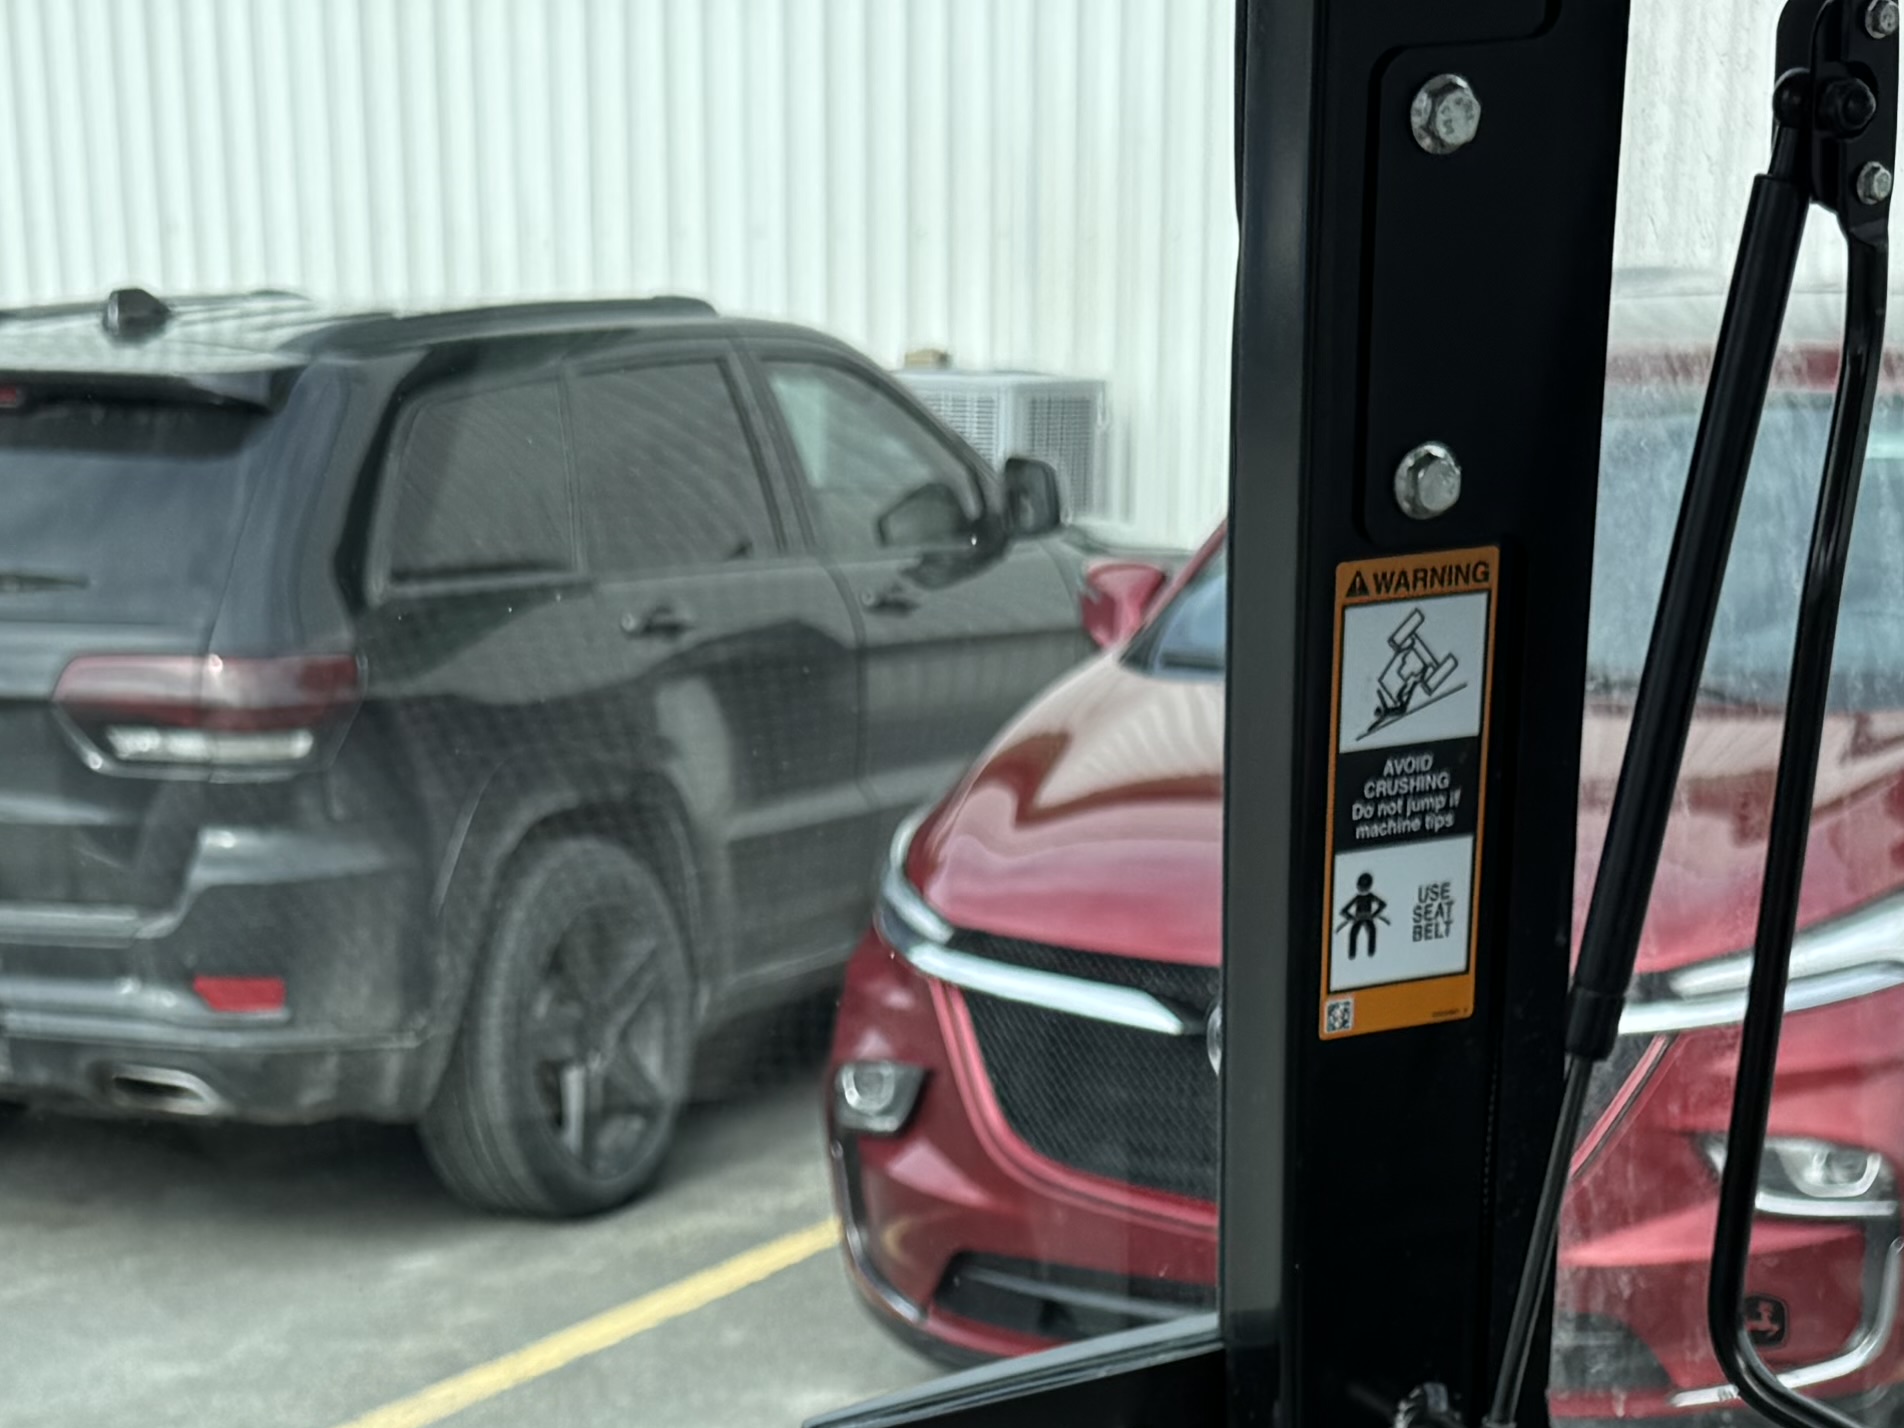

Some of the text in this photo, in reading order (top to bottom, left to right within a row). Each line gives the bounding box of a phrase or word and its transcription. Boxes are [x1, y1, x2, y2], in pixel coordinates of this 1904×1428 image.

[1372, 560, 1490, 595] WARNING
[1383, 754, 1433, 777] AVOID
[1364, 771, 1450, 799] CRUSHING
[1352, 788, 1461, 821] Do not jump if
[1356, 811, 1455, 839] machine tips
[1418, 882, 1451, 904] USE
[1412, 900, 1454, 924] SEAT
[1412, 920, 1453, 943] BELT
